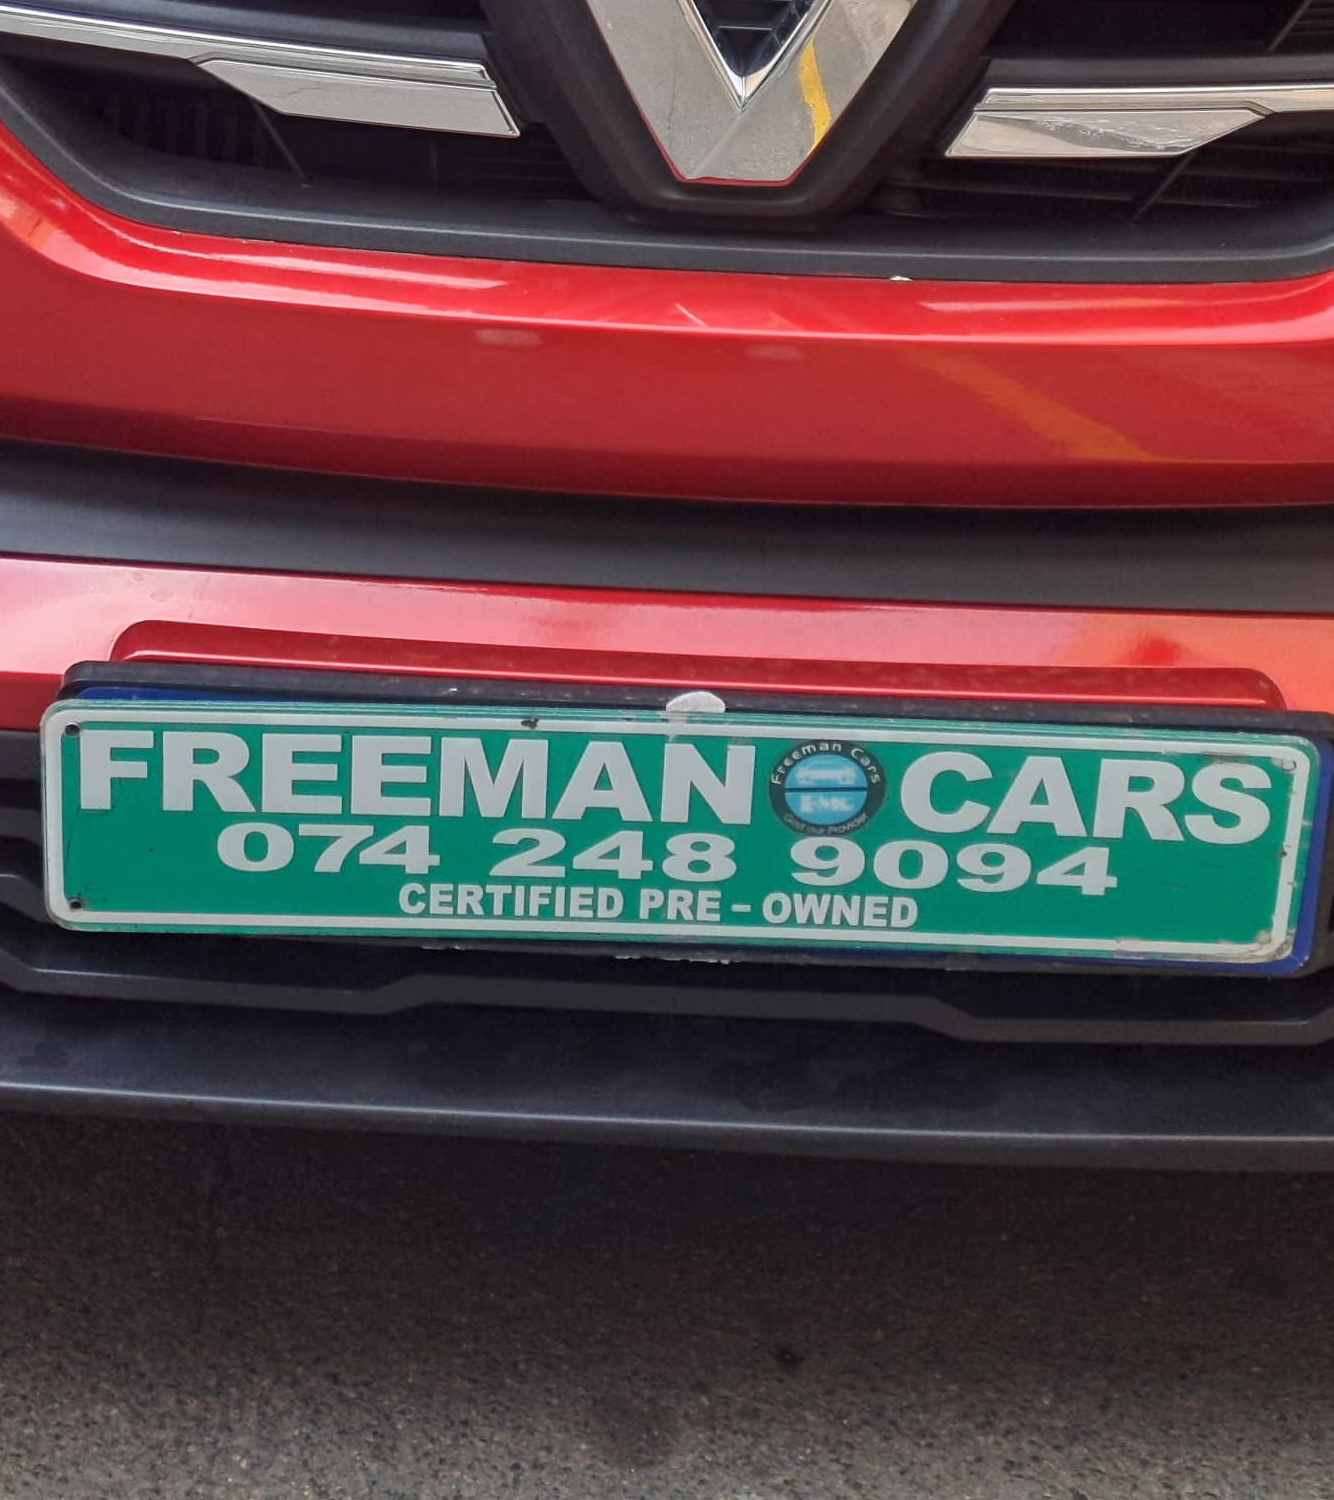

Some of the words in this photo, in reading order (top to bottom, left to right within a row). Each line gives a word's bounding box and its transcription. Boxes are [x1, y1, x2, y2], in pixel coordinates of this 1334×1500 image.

[78, 730, 756, 825] FREEMAN
[900, 751, 1272, 844] CARS
[771, 743, 842, 785] Freeman
[851, 748, 881, 784] Cars
[217, 822, 440, 874] 074
[490, 828, 737, 882] 248
[790, 836, 1117, 896] 9094
[399, 882, 624, 918] CERTIFIED
[640, 889, 721, 922] PRE
[762, 891, 918, 928] OWNED
